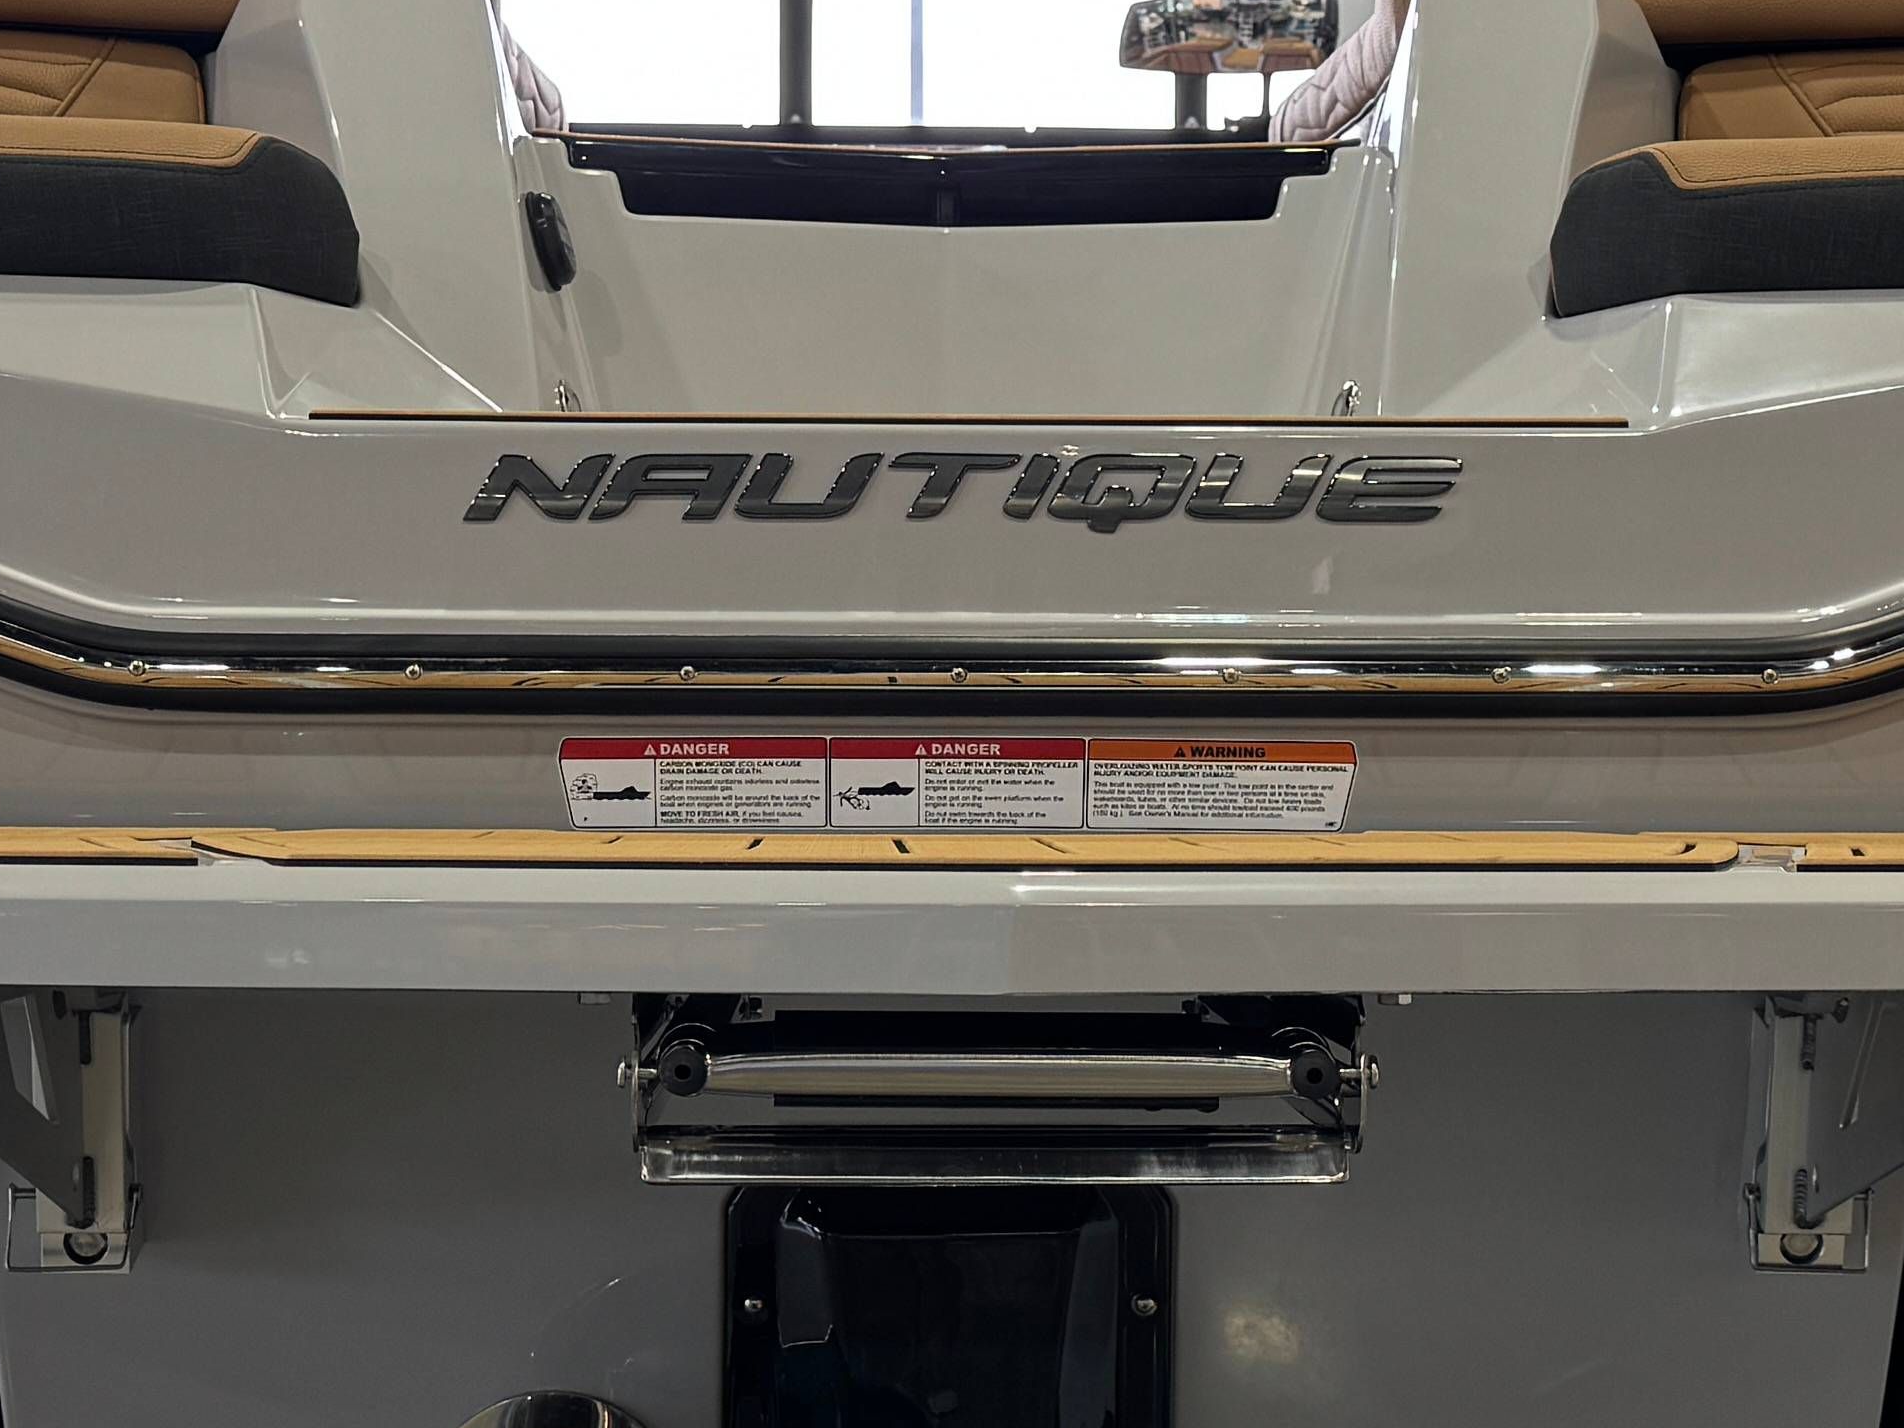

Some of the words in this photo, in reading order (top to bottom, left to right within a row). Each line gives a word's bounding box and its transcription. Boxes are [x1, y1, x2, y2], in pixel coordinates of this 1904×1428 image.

[462, 452, 1464, 534] NAUTIQUE
[659, 743, 730, 756] DANGER
[931, 743, 1001, 756] DANGER
[1190, 746, 1266, 758] WARNING
